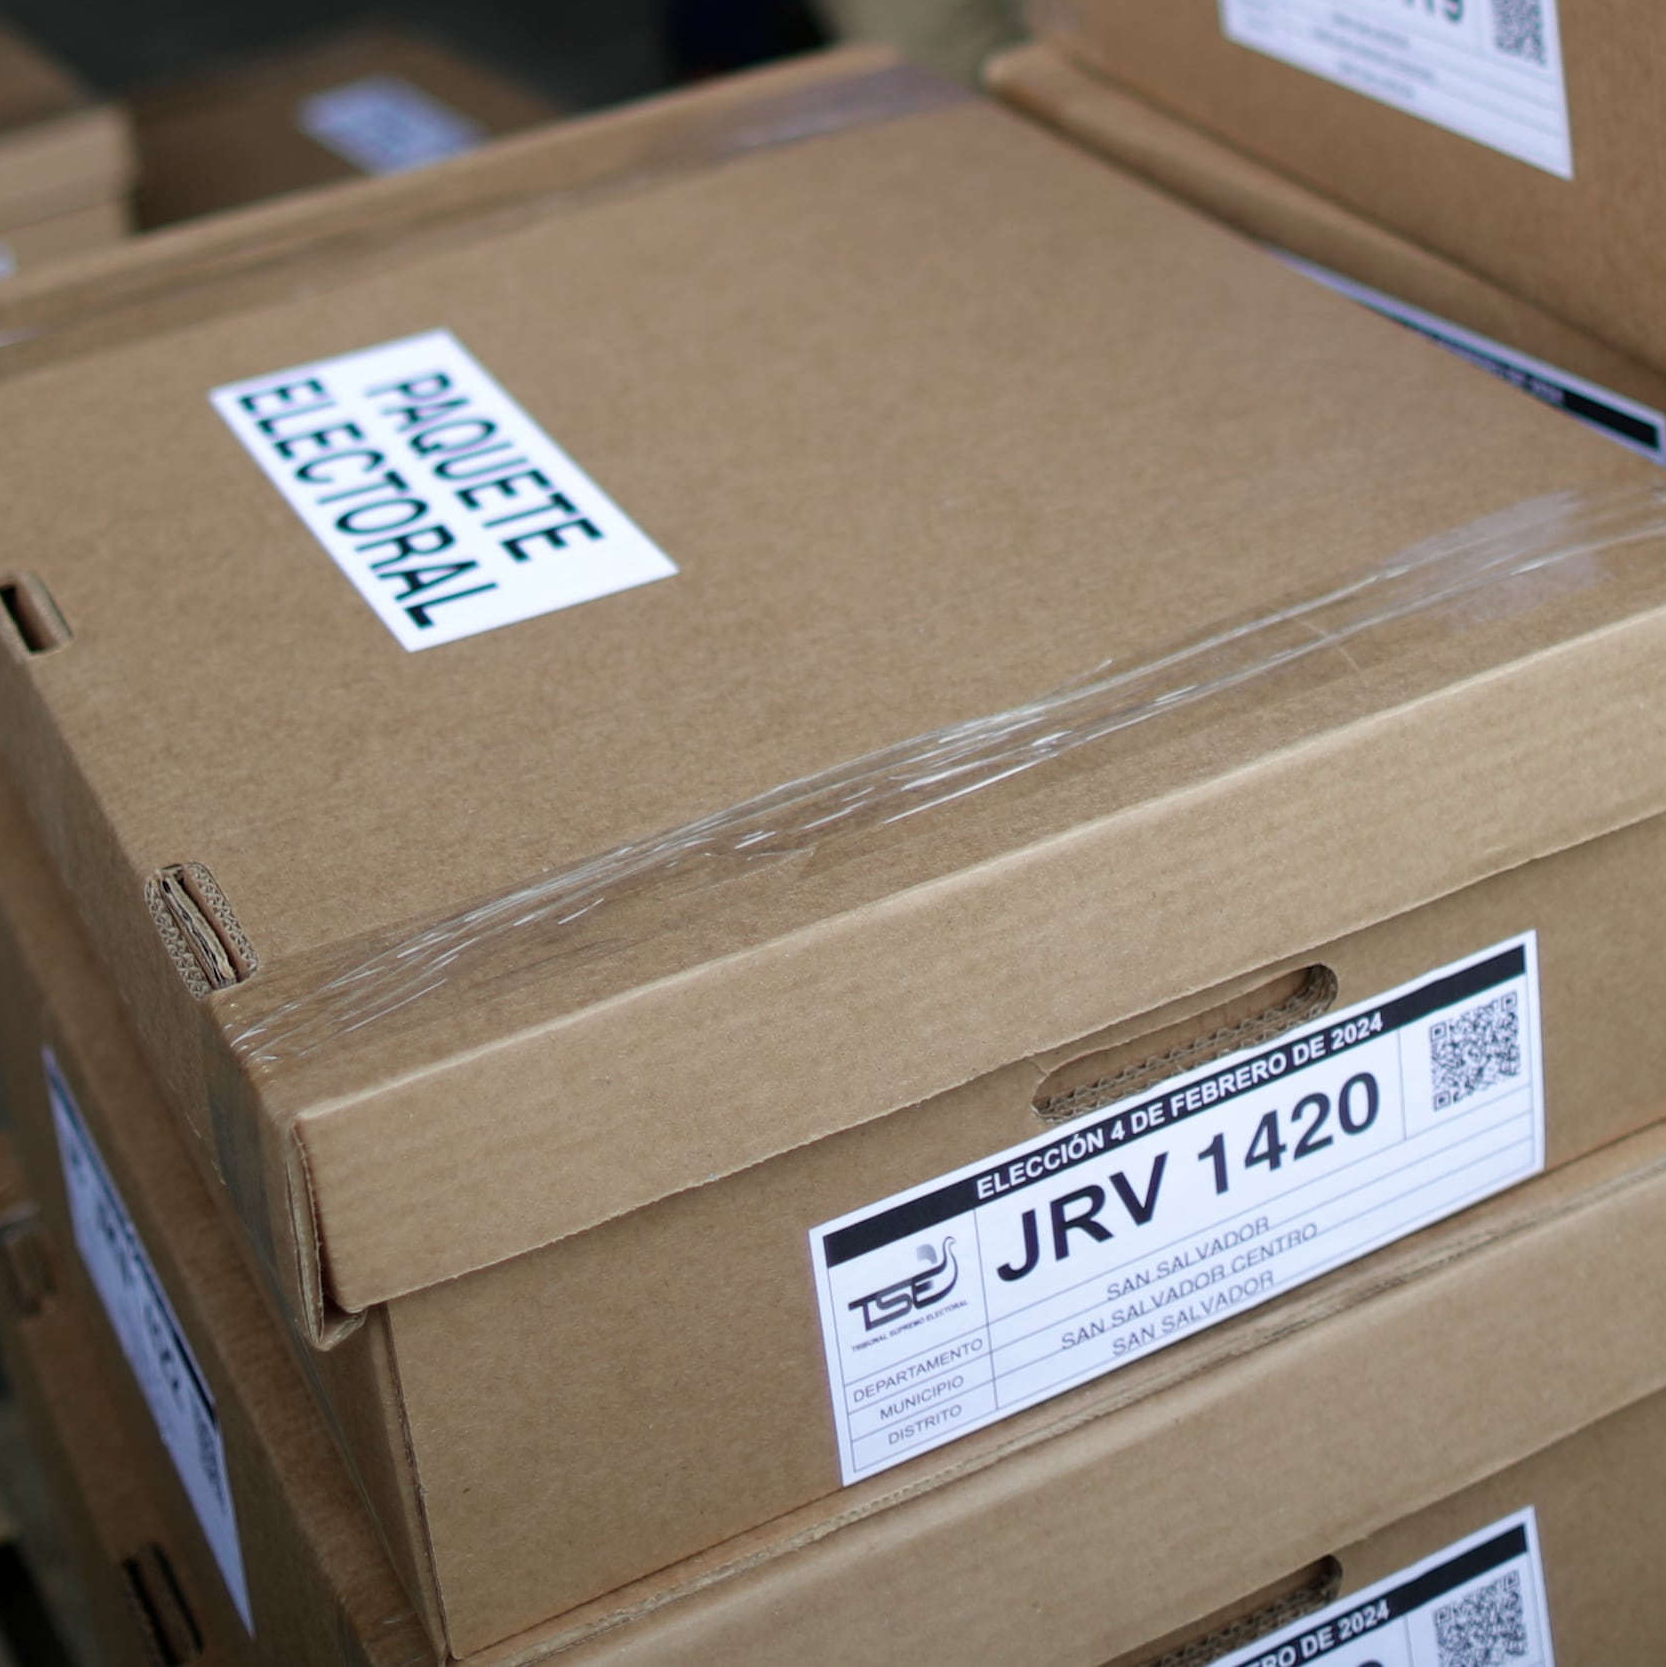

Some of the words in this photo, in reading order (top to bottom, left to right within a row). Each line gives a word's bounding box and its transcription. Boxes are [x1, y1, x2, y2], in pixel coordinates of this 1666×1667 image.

[238, 376, 498, 629] ELECTORAL
[364, 370, 605, 563] PAQUETE
[976, 1127, 1104, 1200] ELECCIÓN
[1110, 1119, 1126, 1142] 4
[1131, 1103, 1165, 1134] DE
[1171, 1056, 1286, 1118] FEBRERO
[1292, 1038, 1326, 1067] DE
[1330, 1012, 1384, 1052] 2024
[996, 1151, 1169, 1283] JRV
[1197, 1071, 1380, 1196] 1420
[1061, 1321, 1105, 1352] SAN
[1112, 1264, 1226, 1329] SALVADOR
[1231, 1222, 1319, 1273] CENTRO
[1106, 1271, 1152, 1302] SAN
[1156, 1216, 1270, 1281] SALVADOR
[926, 1299, 968, 1323] ELECTORAL
[1112, 1327, 1156, 1357] SAN
[1161, 1270, 1276, 1335] SALVADOR
[852, 1337, 984, 1403] DEPARTAMENTO
[880, 1375, 964, 1422] MUNICIPIO
[888, 1404, 963, 1446] DISTRITO
[1301, 1626, 1335, 1660] DE
[1339, 1599, 1390, 1640] 2024
